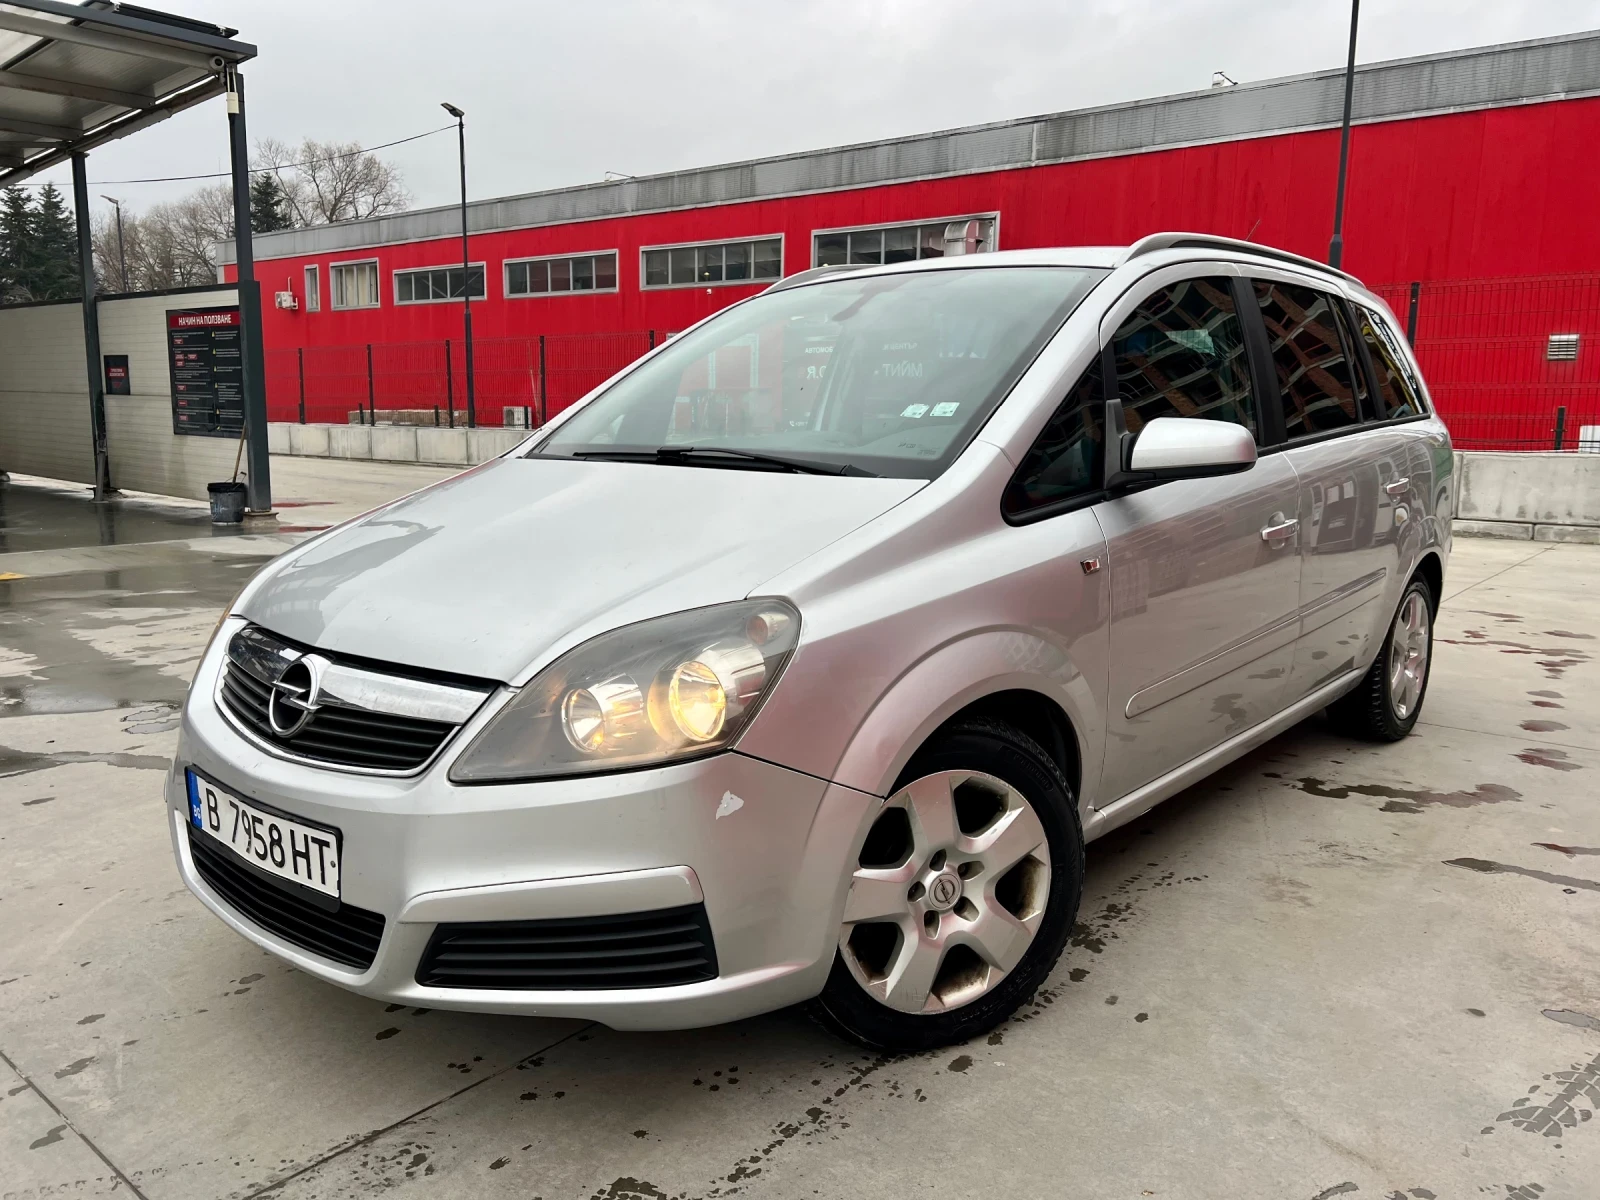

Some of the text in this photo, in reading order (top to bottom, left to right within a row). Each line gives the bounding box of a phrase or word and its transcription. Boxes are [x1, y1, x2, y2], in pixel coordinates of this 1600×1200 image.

[178, 313, 232, 326] НАЧИН НА ПОЛЗВАНЕ
[193, 804, 201, 818] BG
